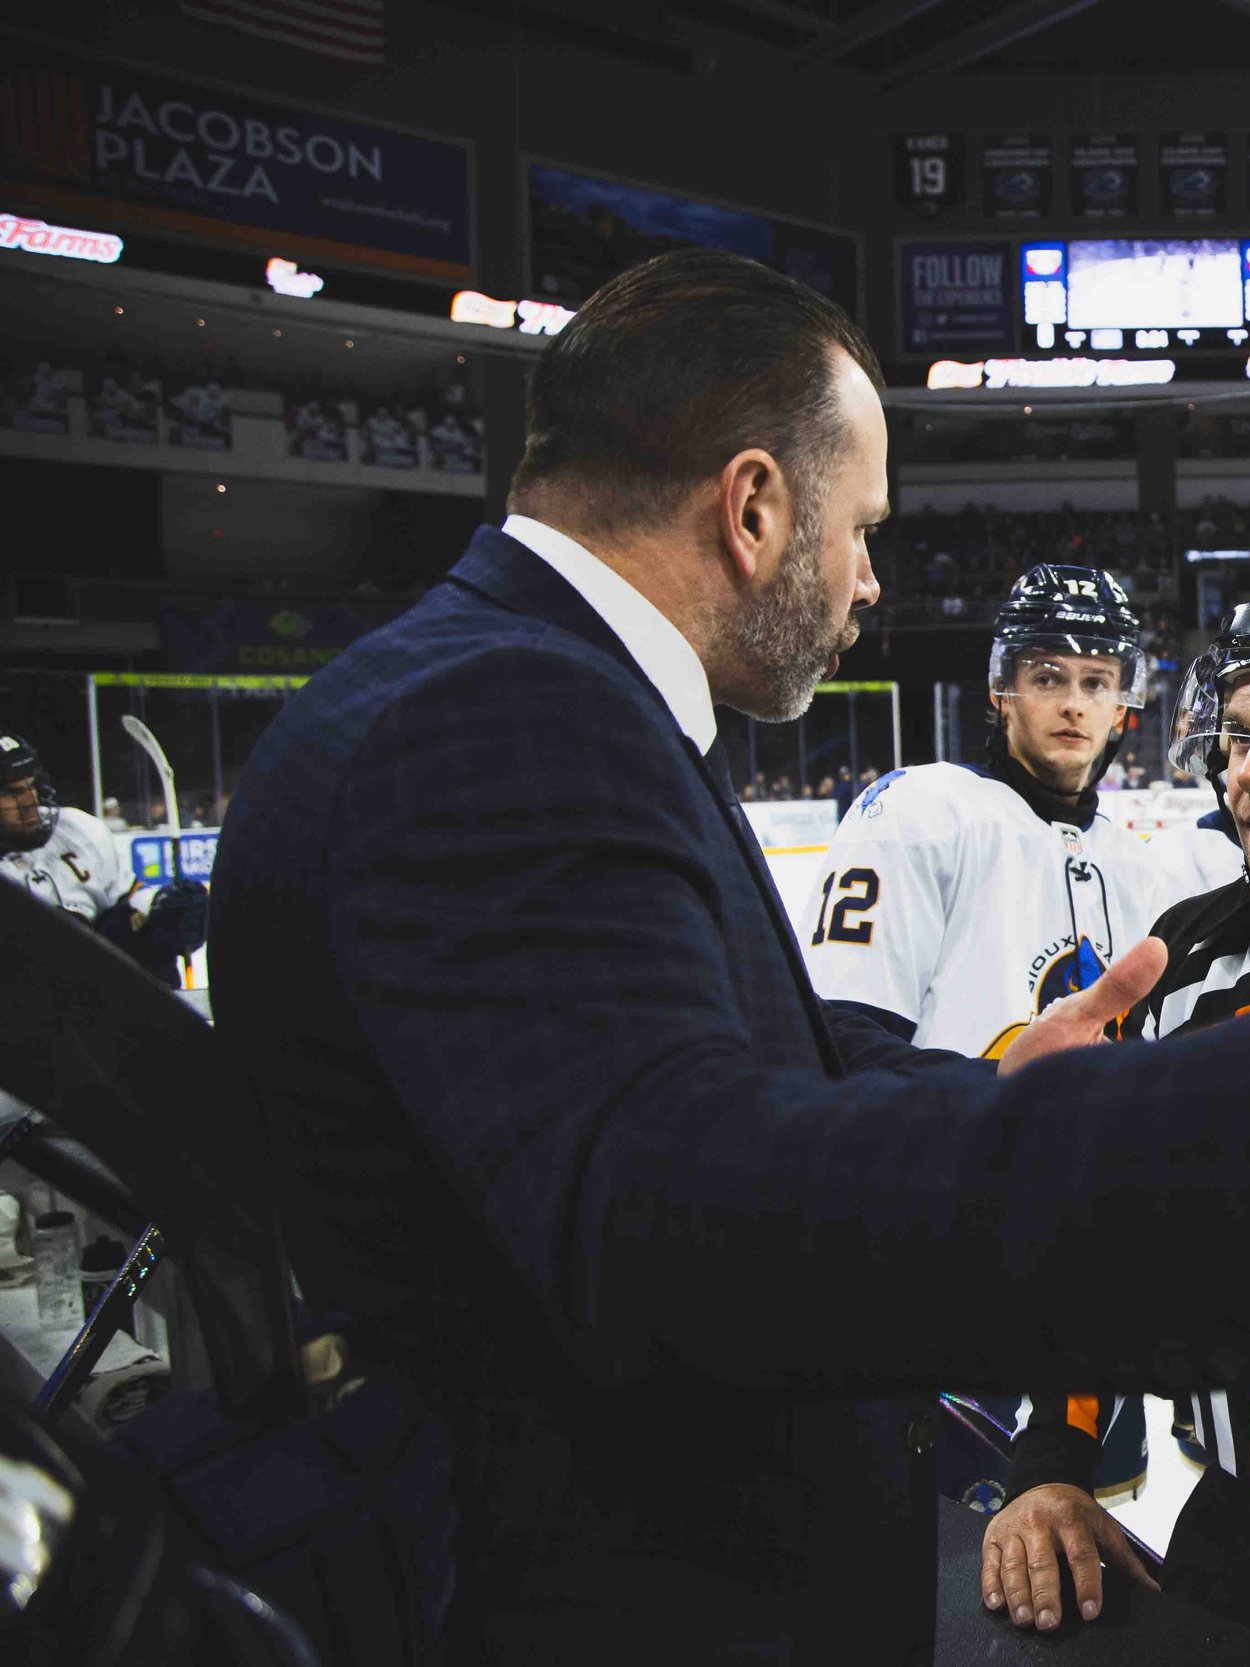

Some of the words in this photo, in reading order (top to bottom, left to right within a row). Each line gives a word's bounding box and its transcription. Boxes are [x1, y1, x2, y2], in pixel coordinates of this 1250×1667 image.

[96, 86, 384, 183] JACOBSON
[96, 130, 281, 204] PLAZA
[910, 157, 946, 194] 19
[0, 217, 120, 259] Farms
[913, 254, 1003, 286] FOLLOW
[1063, 579, 1098, 597] 12
[1055, 611, 1106, 623] BAUER
[811, 868, 880, 946] 12
